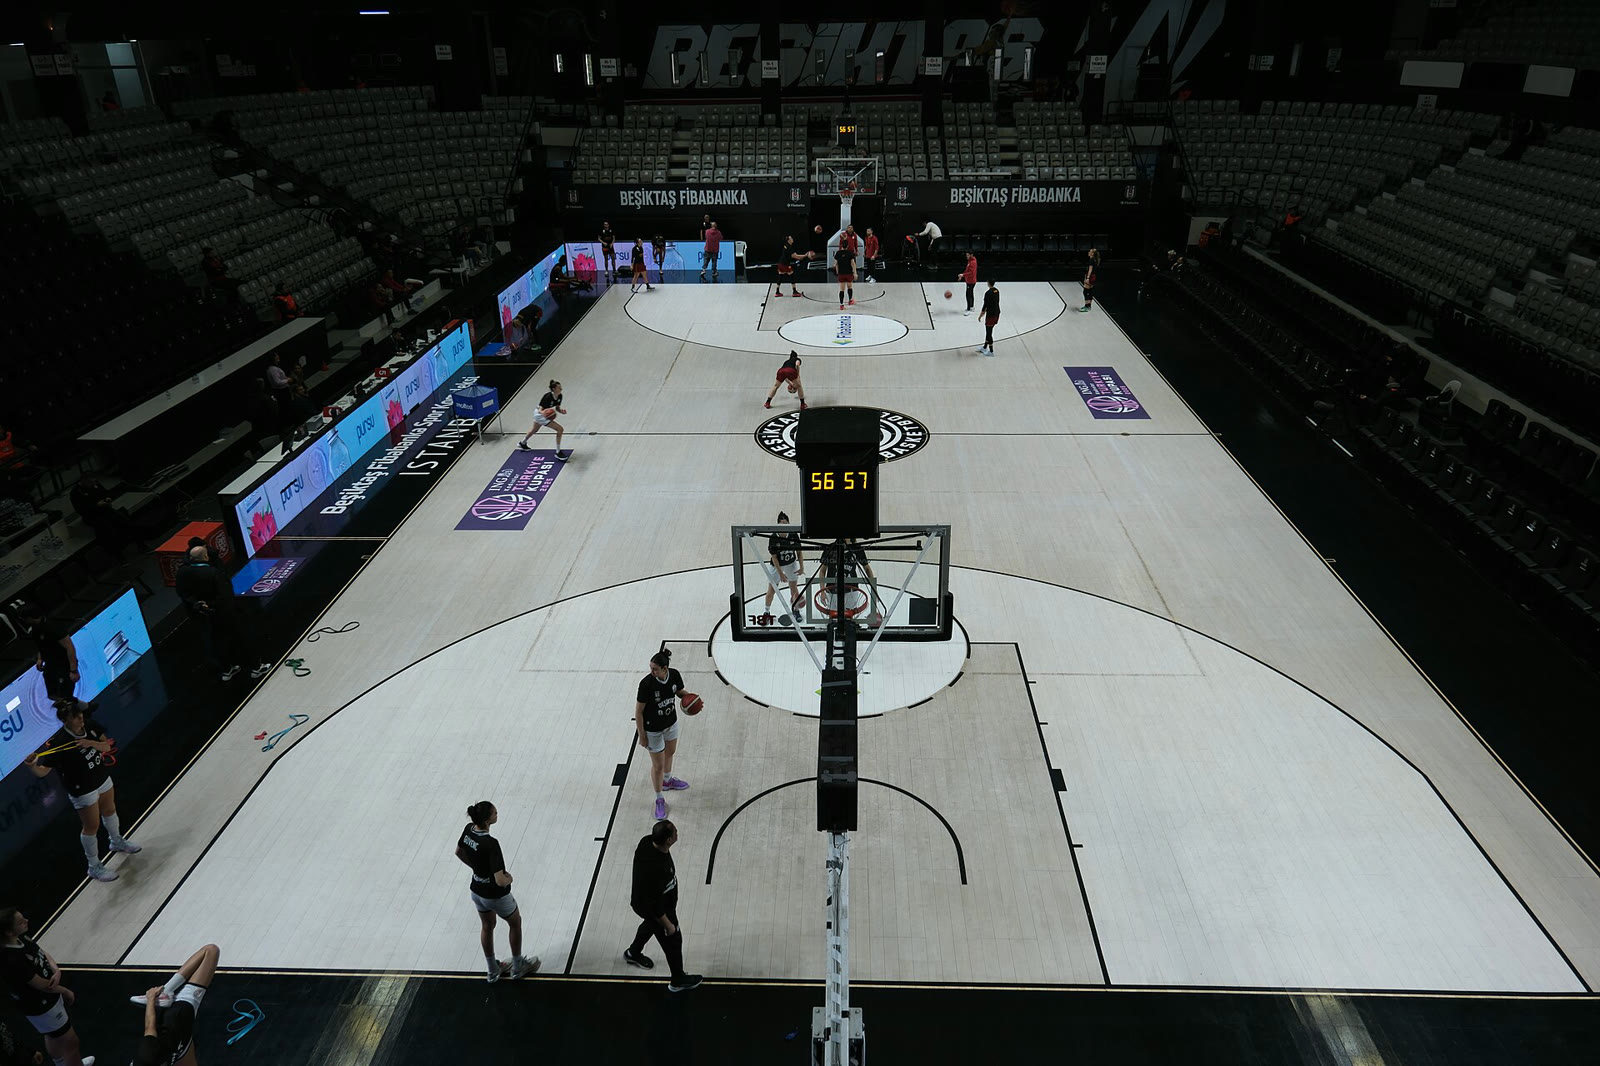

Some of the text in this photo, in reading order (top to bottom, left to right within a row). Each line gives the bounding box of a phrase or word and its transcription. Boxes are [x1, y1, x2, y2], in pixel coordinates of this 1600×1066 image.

[619, 187, 749, 209] BEŞİKTAŞ FİBABANKA
[949, 185, 1082, 207] BEŞİKTAŞ FİBABANKA
[356, 413, 376, 445] pursu
[319, 471, 390, 515] Beşiktaş
[366, 427, 428, 470] Fibabanka
[413, 410, 446, 427] Spor
[398, 418, 479, 476] ISTANB
[525, 461, 555, 492] KUPASI
[811, 472, 868, 491] 56 57
